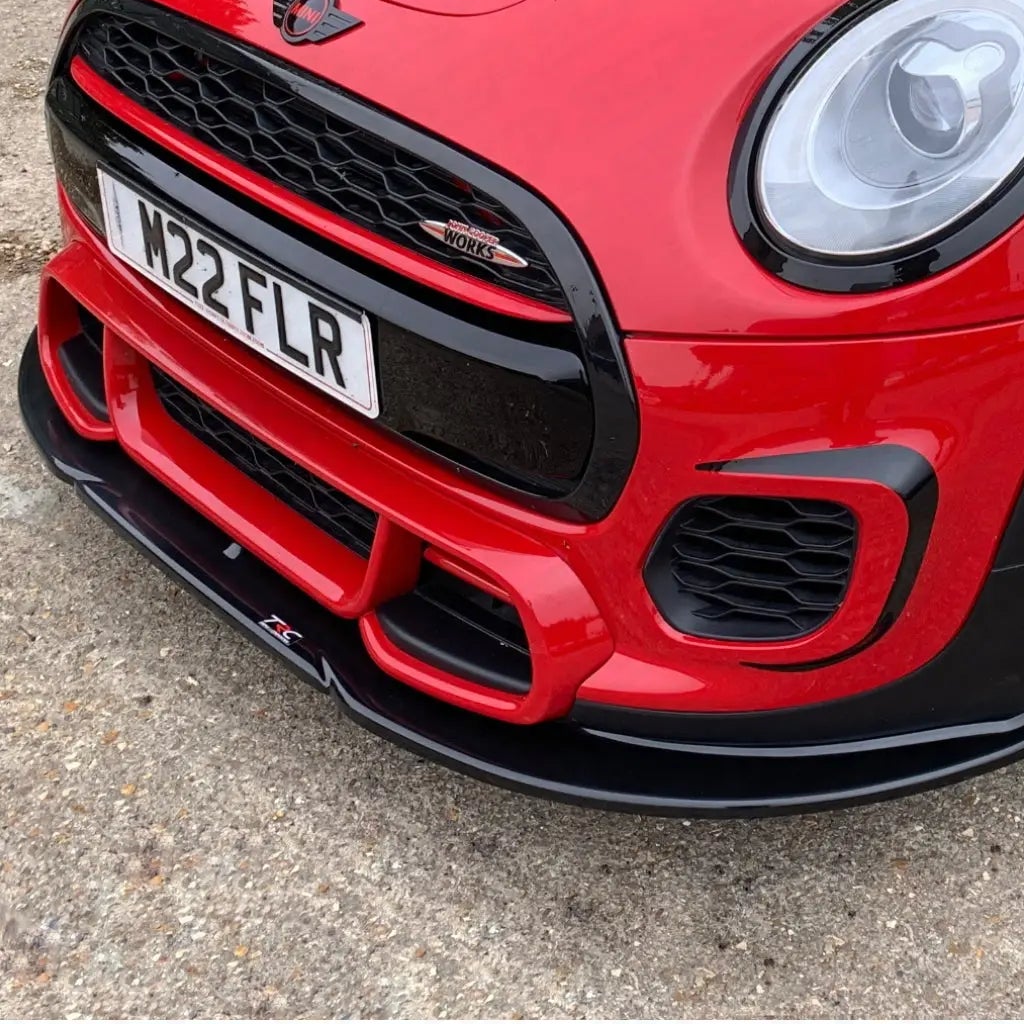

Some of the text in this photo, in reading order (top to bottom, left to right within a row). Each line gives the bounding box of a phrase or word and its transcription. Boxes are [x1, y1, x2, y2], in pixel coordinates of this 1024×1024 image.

[138, 199, 229, 319] M22
[238, 261, 346, 389] FLR
[444, 227, 497, 260] WORKS
